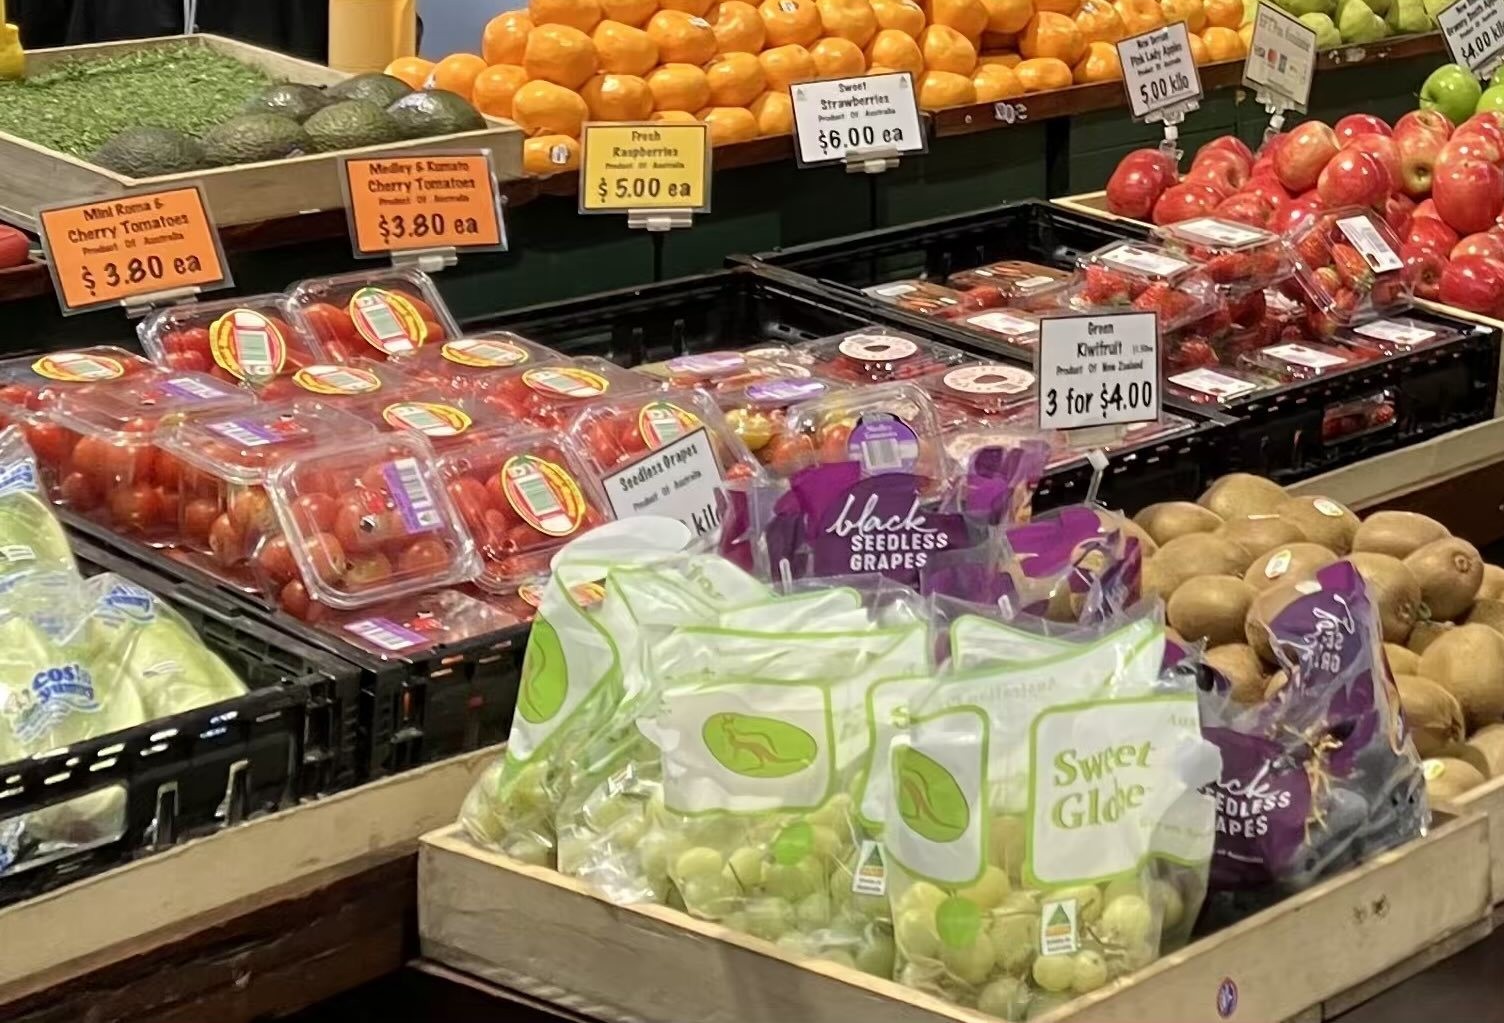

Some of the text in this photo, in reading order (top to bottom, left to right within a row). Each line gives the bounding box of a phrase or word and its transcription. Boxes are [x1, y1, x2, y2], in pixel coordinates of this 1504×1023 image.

[839, 82, 866, 92] Sweet
[821, 95, 889, 110] Strawberries
[632, 131, 661, 141] Fresh
[819, 126, 903, 156] $6.00 ea
[613, 147, 678, 158] Raspberries
[369, 163, 411, 175] Medley
[427, 161, 469, 172] Kumato
[368, 178, 475, 193] Cherry Tomatoes
[668, 182, 691, 197] ea
[83, 198, 164, 221] Mini Roma &
[68, 214, 189, 243] Cherry Tomatoes
[378, 213, 479, 244] $3.80 ea
[173, 255, 202, 275] ea
[1088, 321, 1114, 335] Green
[1077, 341, 1122, 358] Kiwifruit
[1056, 366, 1083, 375] Product
[1102, 363, 1116, 372] New
[1046, 381, 1152, 418] 3 for $4.00
[620, 444, 698, 492] Seedless Grapes
[825, 493, 938, 537] black
[851, 532, 948, 552] SEEDLESS
[850, 552, 928, 571] GRAPES
[1054, 741, 1153, 786] Sweet
[1053, 777, 1145, 829] Globe
[1215, 791, 1291, 817] EDLESS
[1215, 815, 1268, 838] APES
